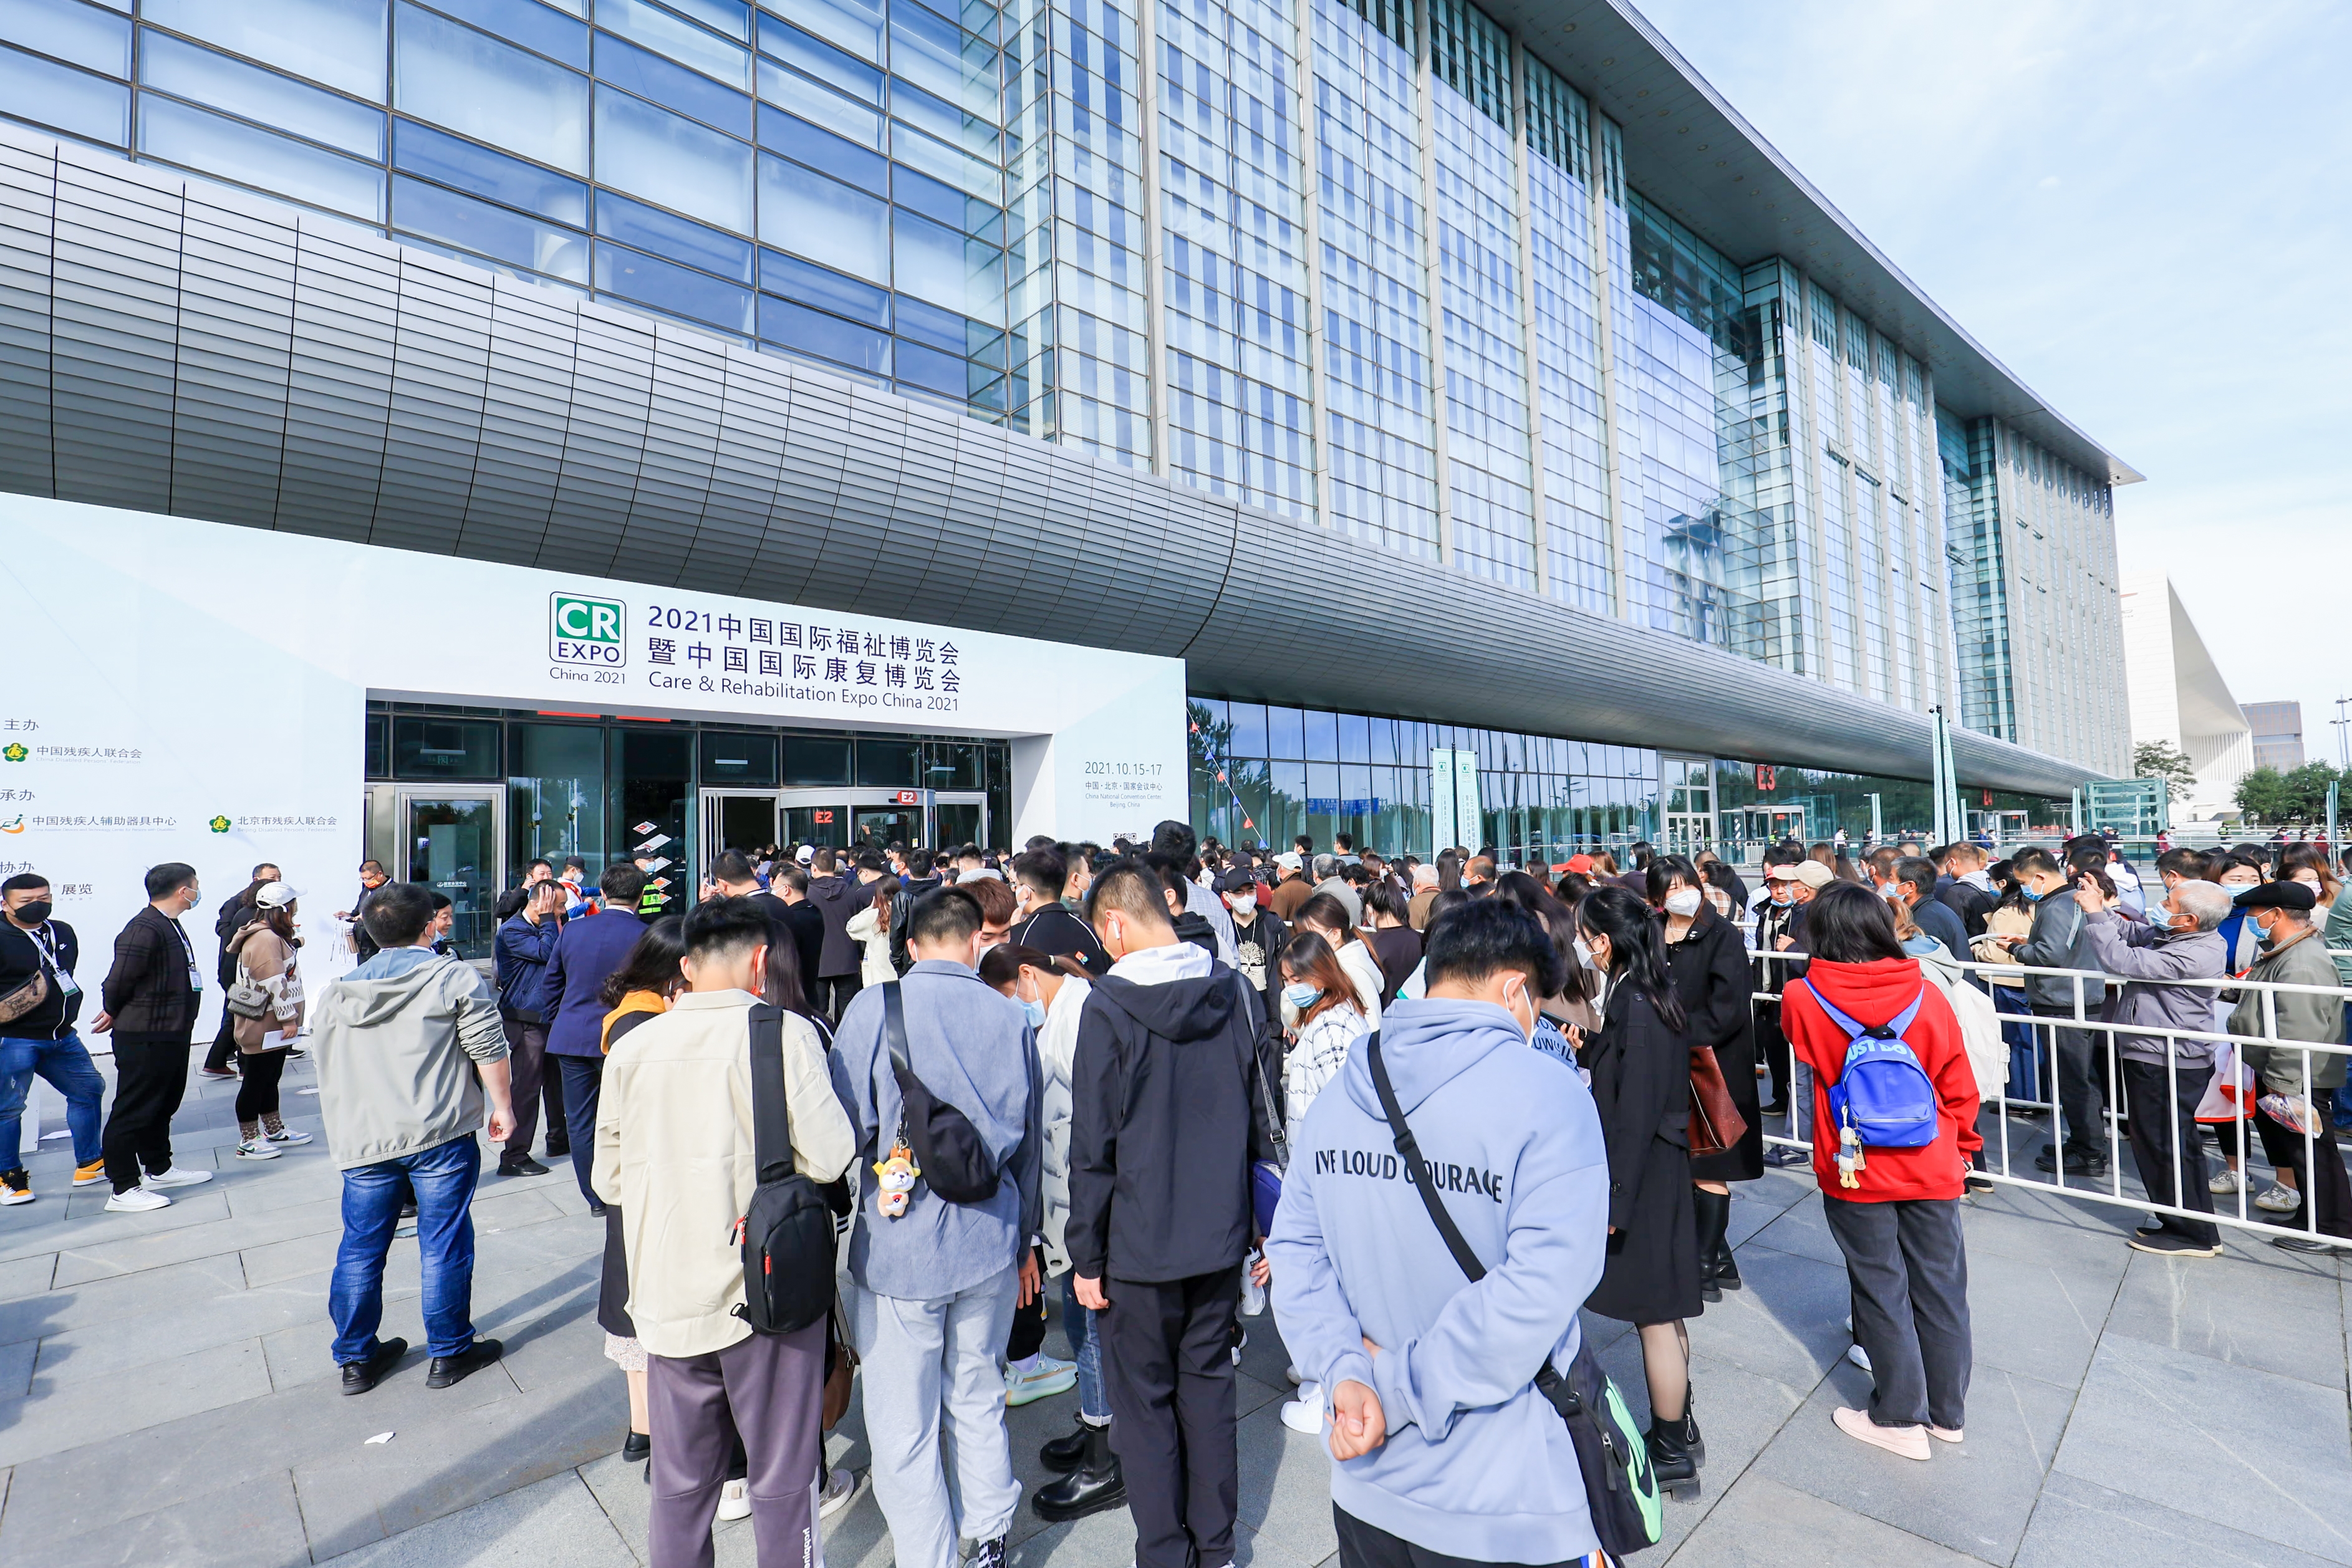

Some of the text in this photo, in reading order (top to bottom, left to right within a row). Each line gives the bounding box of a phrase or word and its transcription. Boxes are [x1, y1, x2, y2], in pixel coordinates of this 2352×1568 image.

[558, 602, 620, 640] CR
[648, 605, 959, 666] 2021中国国际福祉博览会
[558, 642, 620, 662] EXPO
[648, 637, 960, 693] 暨中国国际康复博览会
[549, 667, 625, 685] China 2021
[649, 671, 958, 711] Care & Rehabilitation Expo China 2021
[4, 719, 39, 731] 主办
[37, 746, 142, 759] 中国残疾人联合会
[1085, 761, 1162, 776] 2021.10.15-17
[1439, 762, 1446, 771] CR
[1462, 764, 1470, 773] CR
[1755, 764, 1775, 791] E3
[0, 789, 36, 801] 承办
[902, 792, 913, 802] E2
[32, 815, 176, 825] 中国残疾人辅助器具中心
[238, 816, 337, 825] 北京市残疾人联合会
[815, 811, 833, 823] E2
[0, 861, 34, 873] 协办
[62, 883, 93, 895] 展览
[1878, 1042, 1907, 1055] DO
[1342, 1150, 1397, 1180] LOUD
